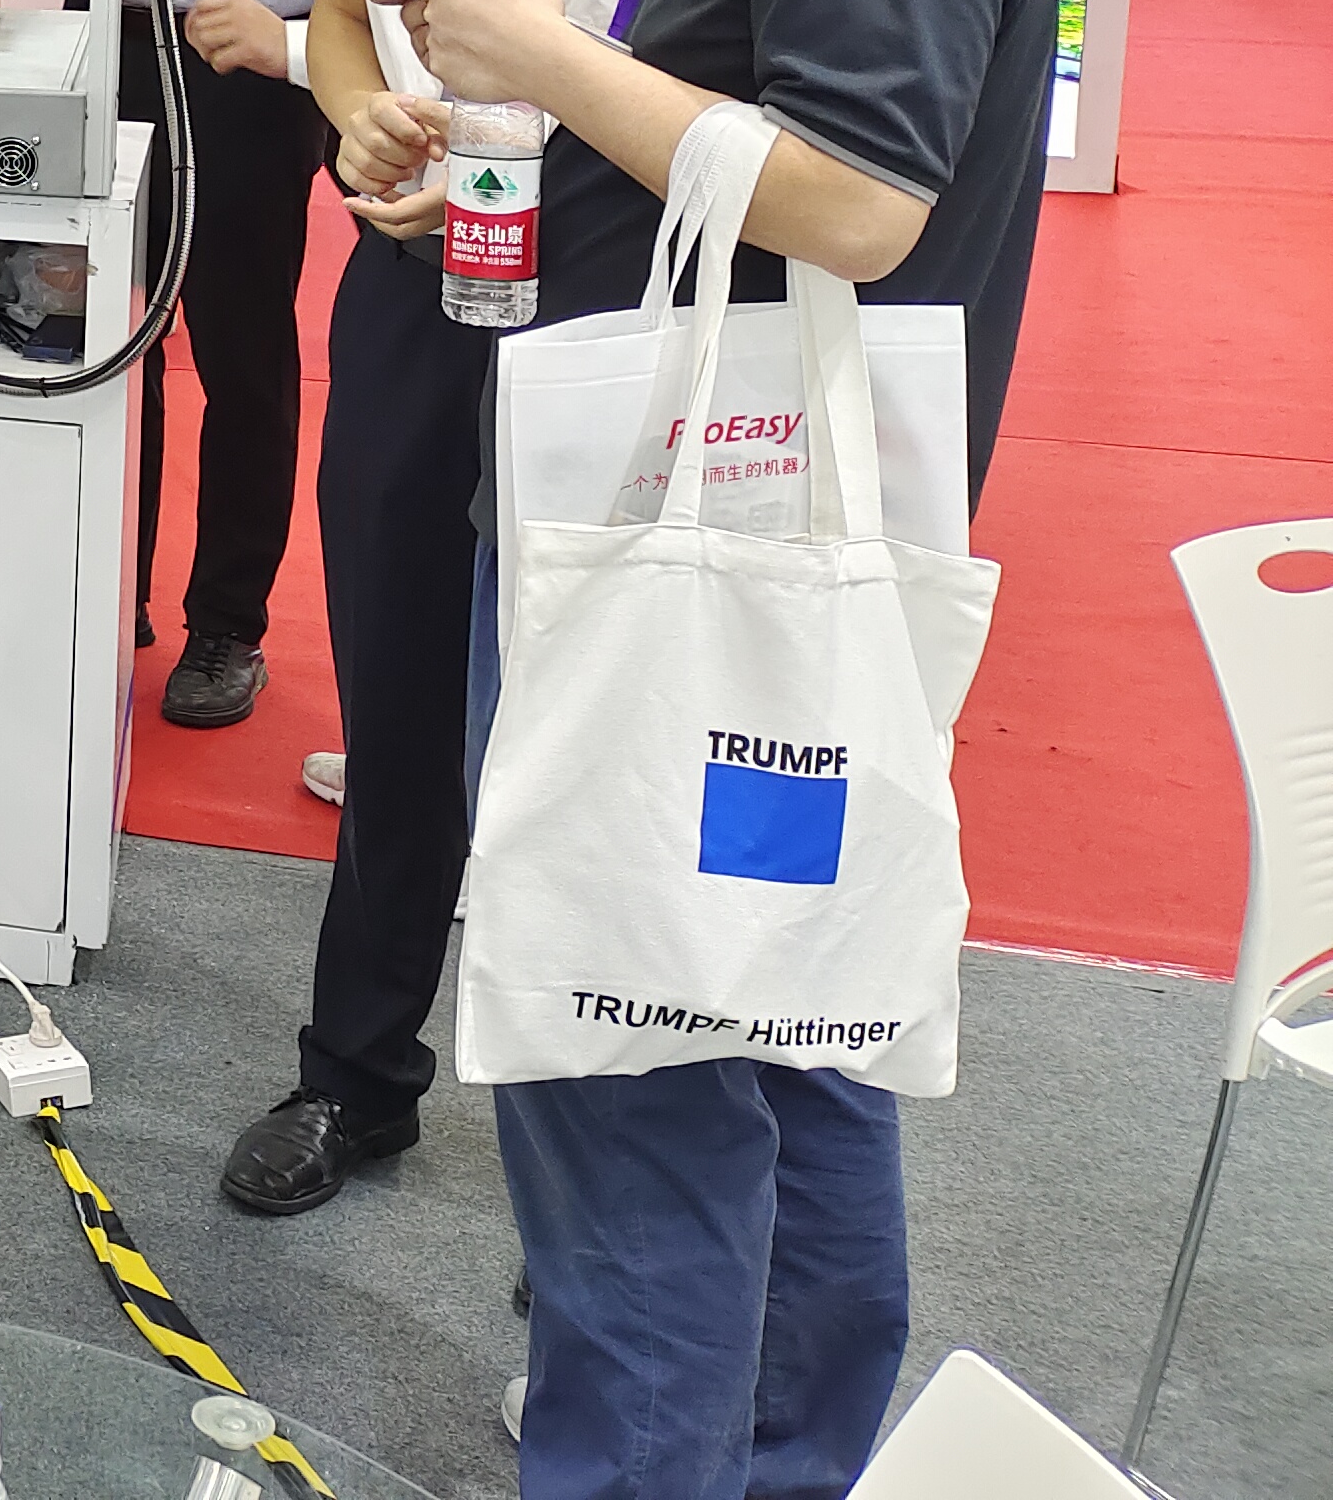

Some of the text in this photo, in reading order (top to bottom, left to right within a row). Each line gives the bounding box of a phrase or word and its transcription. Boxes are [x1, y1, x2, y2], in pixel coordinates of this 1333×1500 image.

[452, 219, 524, 245] 农夫山泉
[665, 411, 804, 450] PoEasy
[707, 729, 848, 776] TRUMPF
[571, 991, 902, 1051] TRUMPF Hüttinger
